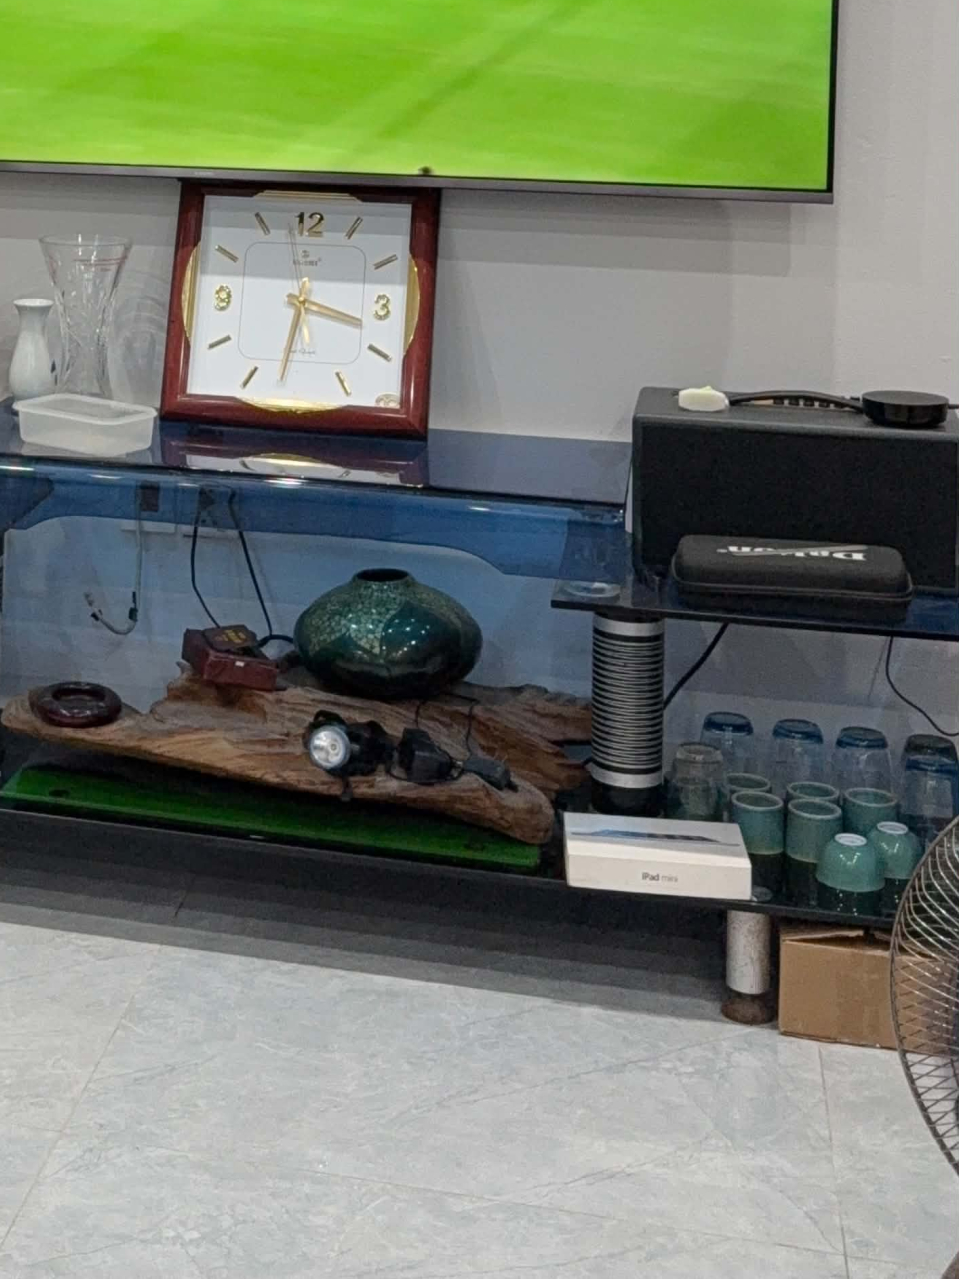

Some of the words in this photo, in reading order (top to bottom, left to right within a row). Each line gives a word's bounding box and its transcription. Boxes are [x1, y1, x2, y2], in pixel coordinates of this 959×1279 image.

[295, 211, 325, 238] 12
[214, 284, 233, 312] 9
[373, 293, 391, 321] 3
[641, 871, 660, 882] iPad
